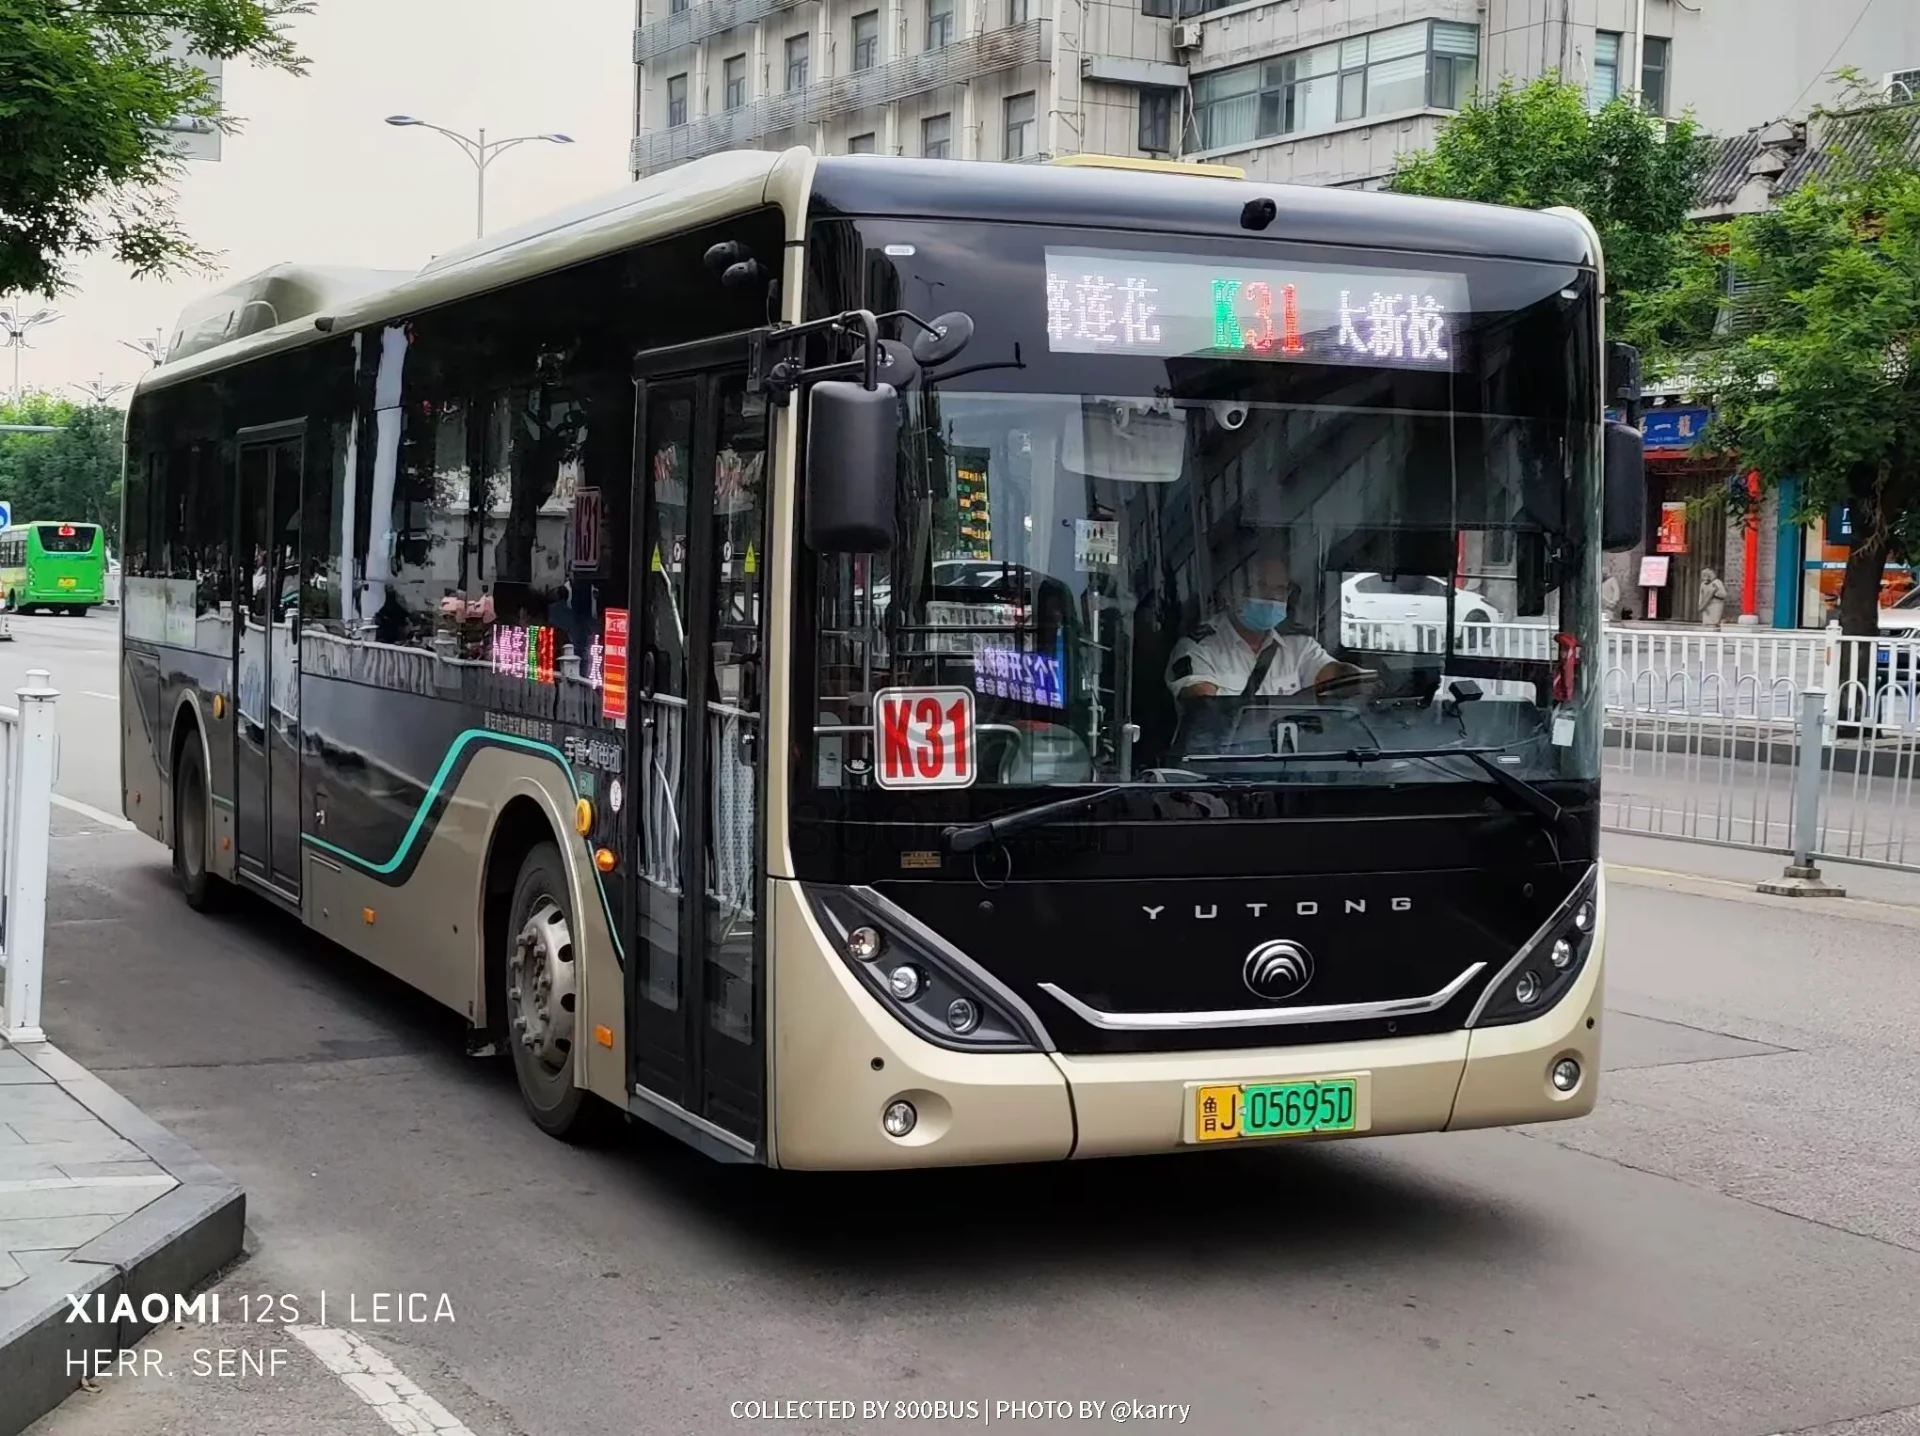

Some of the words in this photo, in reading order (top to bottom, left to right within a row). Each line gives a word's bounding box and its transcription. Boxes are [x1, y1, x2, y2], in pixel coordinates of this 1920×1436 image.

[1211, 278, 1304, 353] K31
[882, 697, 968, 779] K31
[1142, 897, 1412, 920] YUTONG
[1251, 1086, 1353, 1129] 05695D
